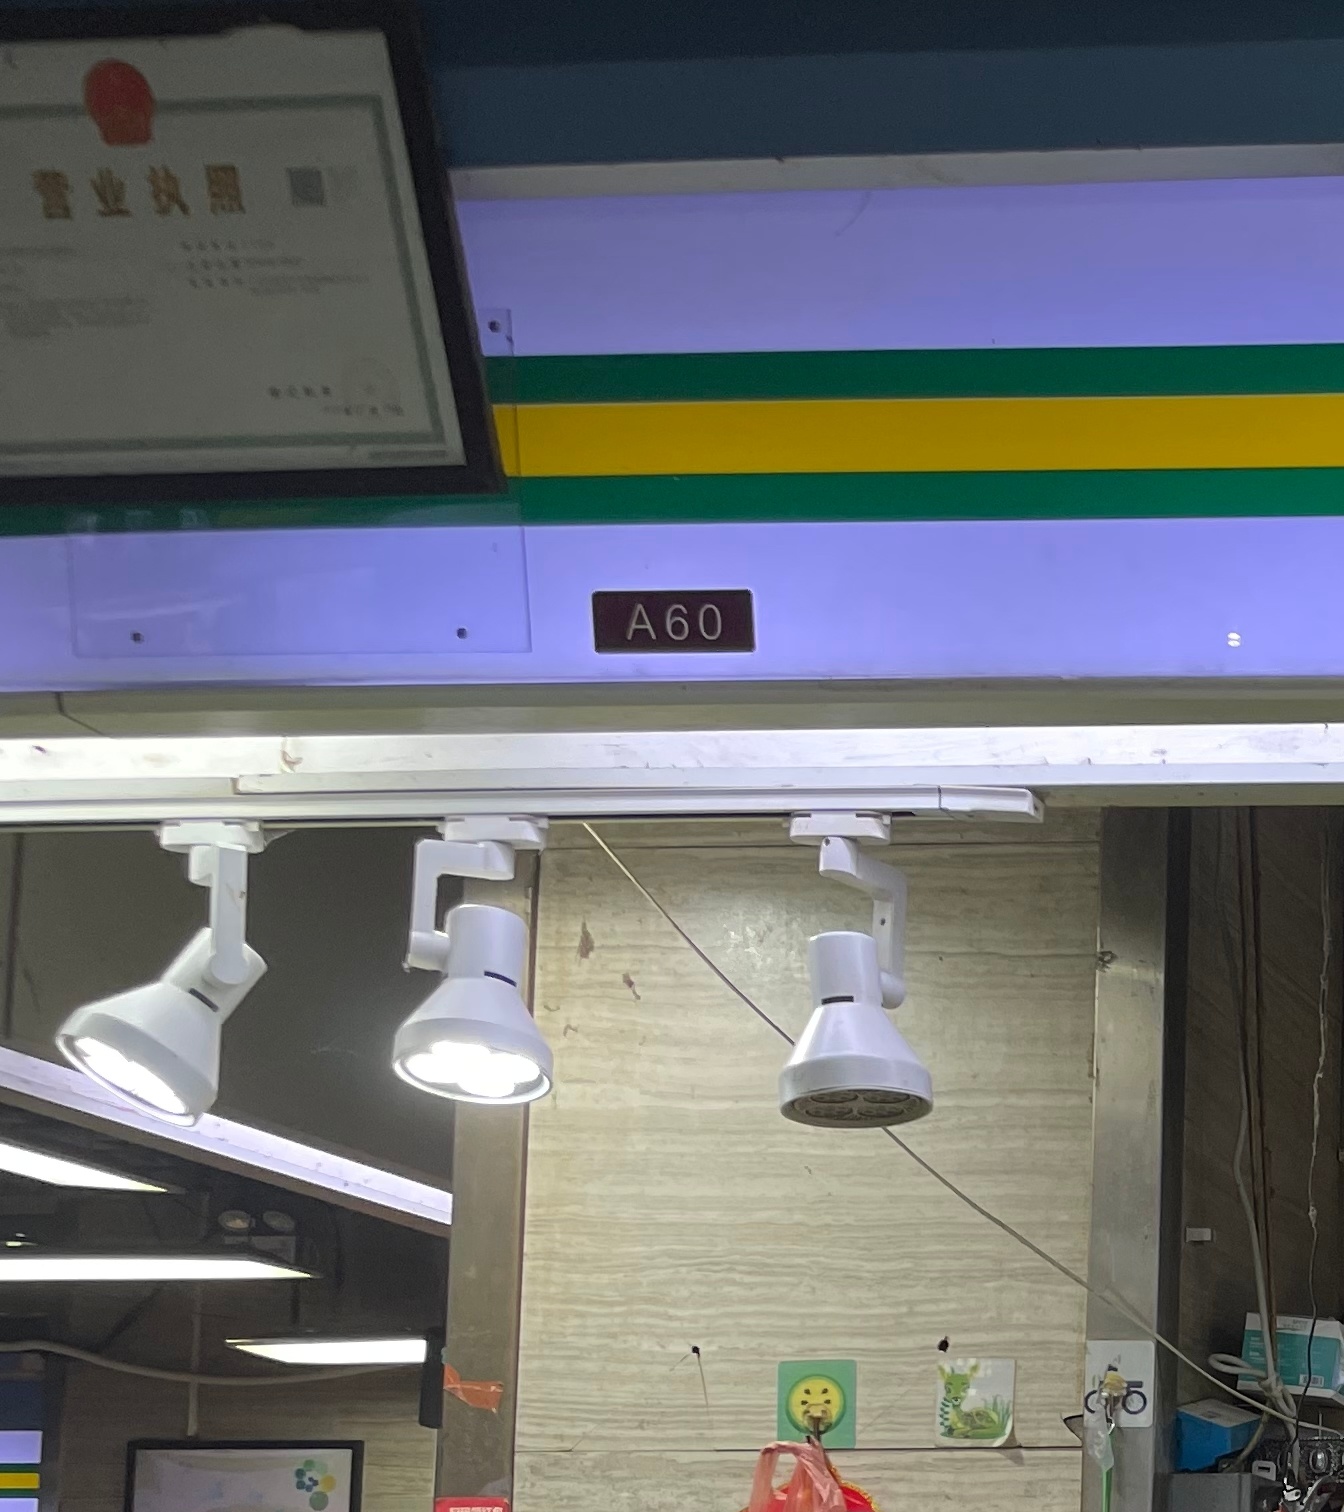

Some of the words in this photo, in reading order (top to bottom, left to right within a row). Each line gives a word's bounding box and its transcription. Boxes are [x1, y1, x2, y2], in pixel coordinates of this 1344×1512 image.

[32, 164, 245, 219] 营业执照
[627, 603, 722, 641] A60
